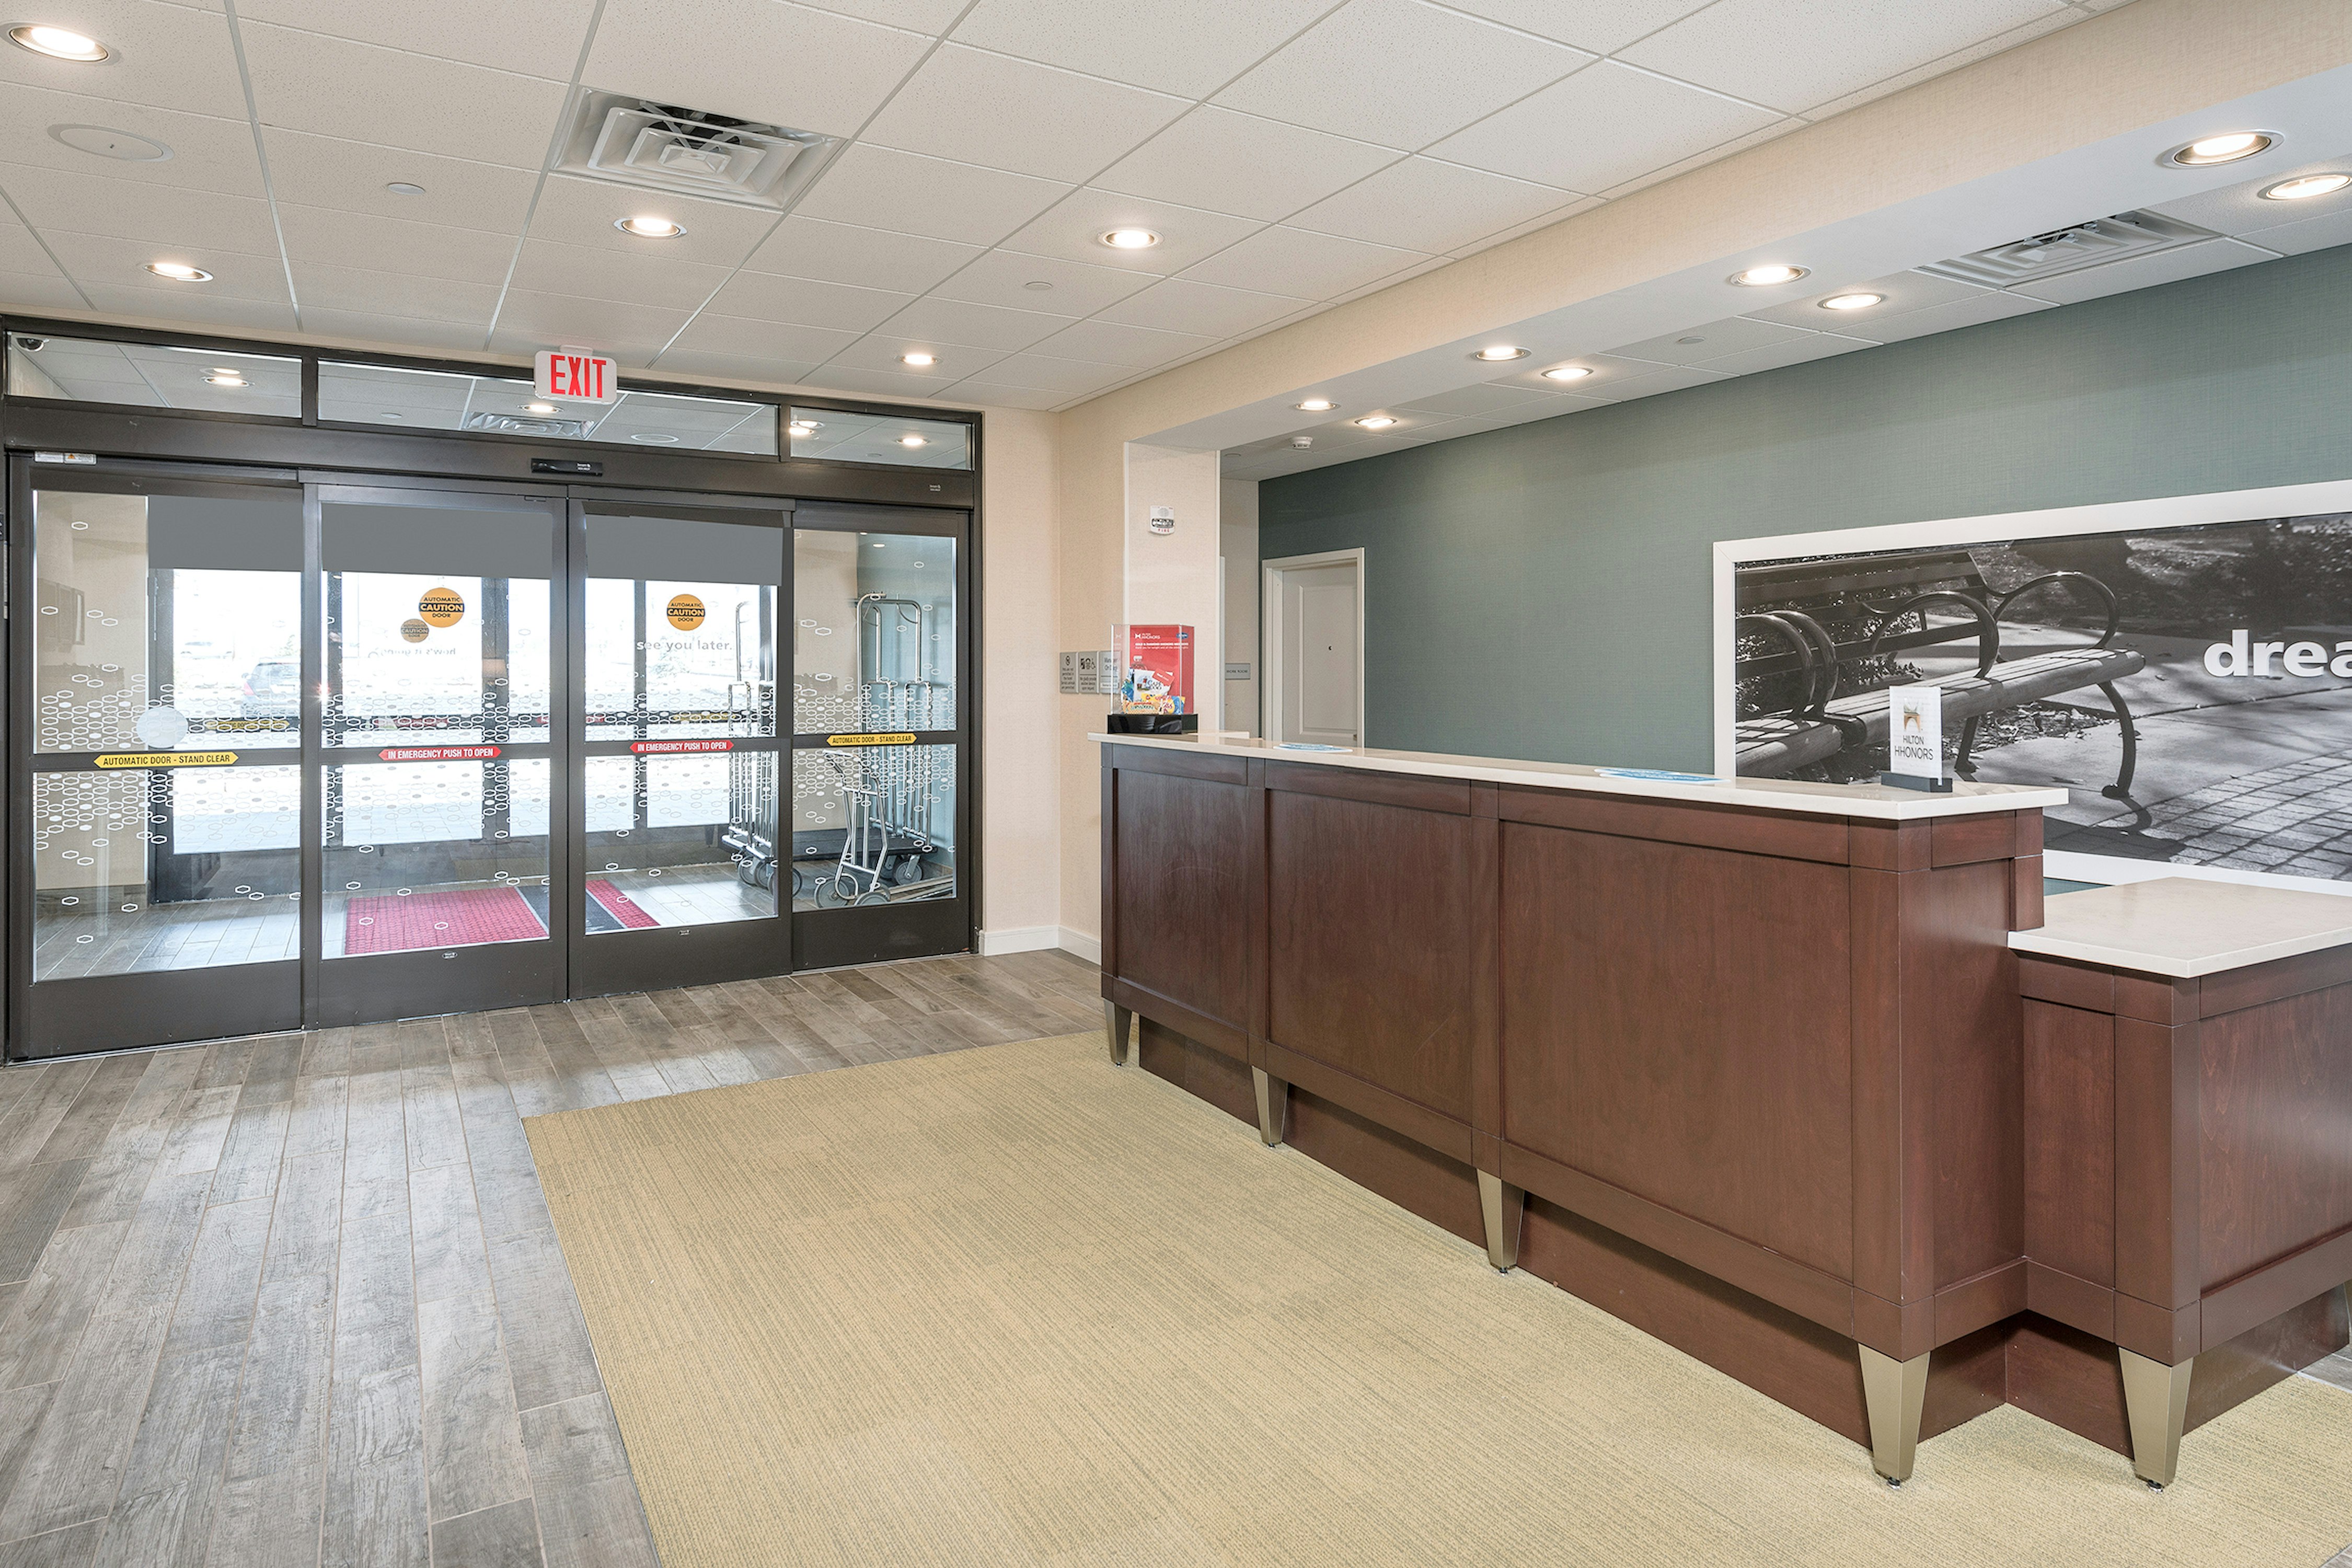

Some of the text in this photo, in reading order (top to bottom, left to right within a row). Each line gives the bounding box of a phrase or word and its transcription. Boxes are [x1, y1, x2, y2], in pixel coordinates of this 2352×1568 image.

[551, 355, 606, 398] EXIT
[637, 640, 732, 652] see you later.
[2204, 628, 2352, 678] drea
[1903, 735, 1924, 745] HILTON
[646, 743, 683, 751] EMERGENCY
[684, 742, 700, 751] PUSH
[398, 750, 441, 758] EMERGENCY
[443, 749, 462, 757] PUSH
[475, 748, 493, 756] OPEN
[1894, 746, 1933, 760] HHONORS
[103, 756, 148, 765] AUTOMATIC
[151, 756, 171, 764] DOOR
